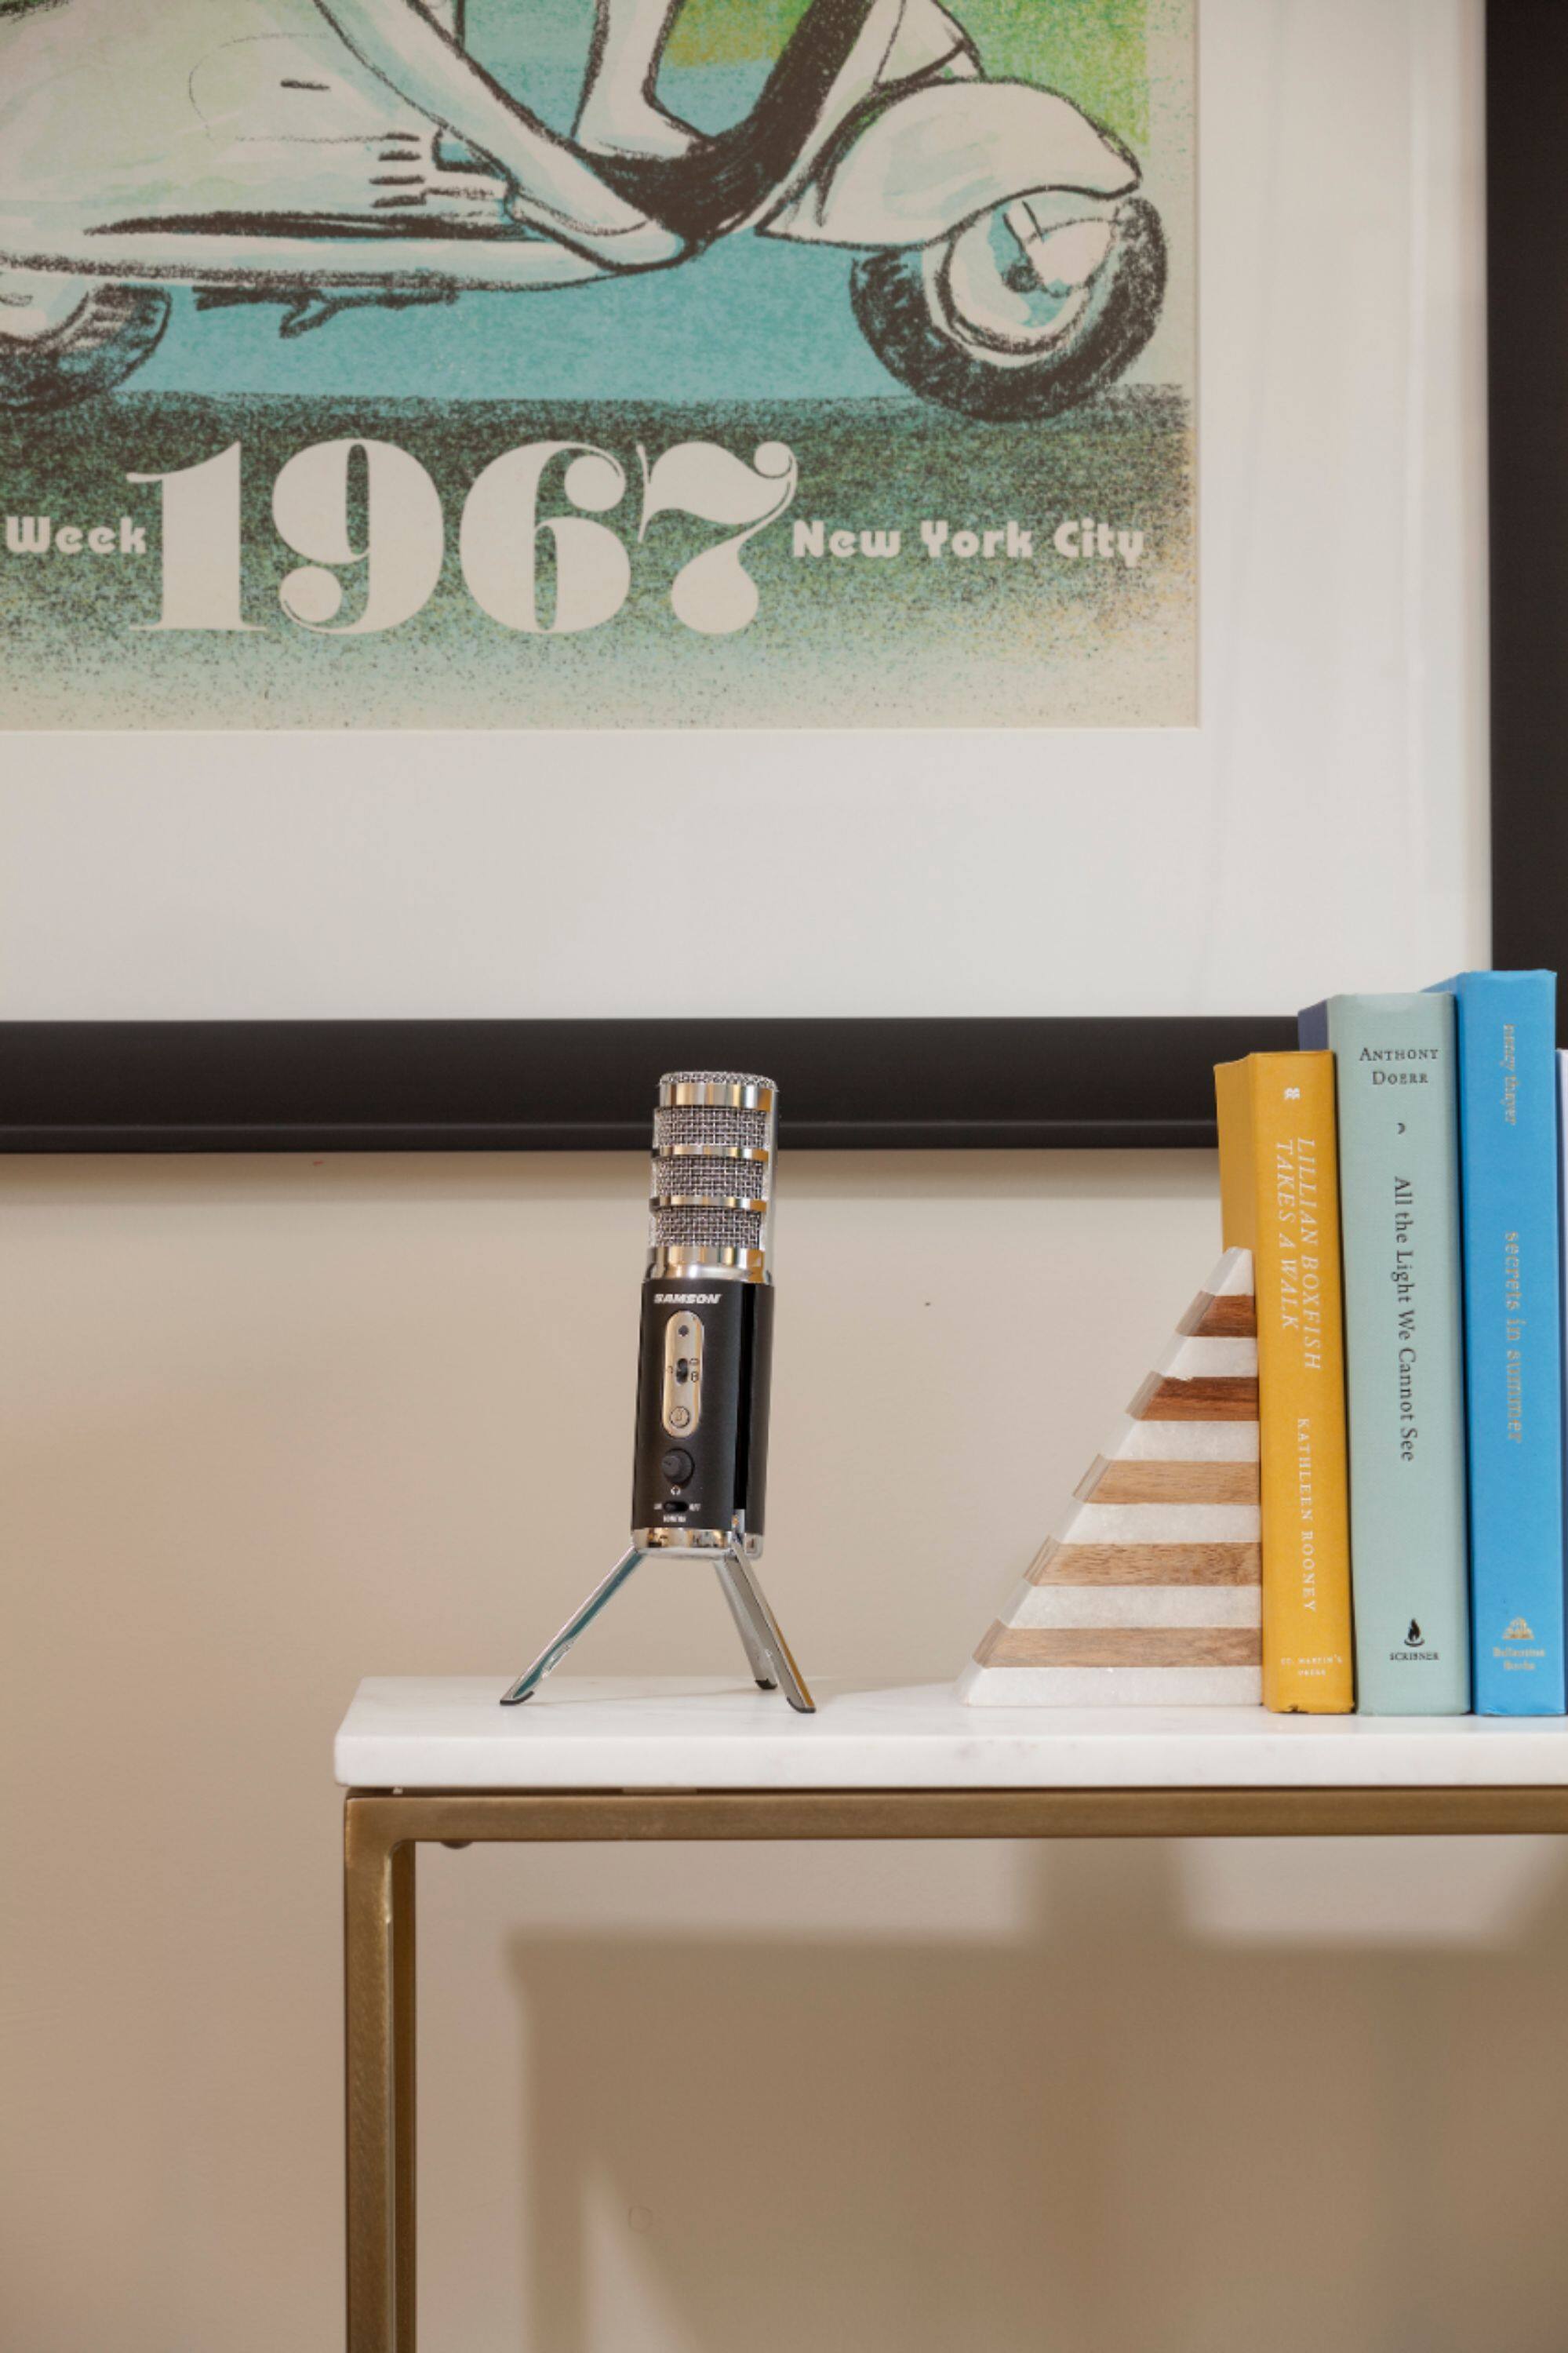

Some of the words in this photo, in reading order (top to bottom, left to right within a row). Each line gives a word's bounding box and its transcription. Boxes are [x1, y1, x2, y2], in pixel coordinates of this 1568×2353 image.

[5, 515, 147, 554] Week
[126, 438, 799, 635] 1967
[791, 519, 902, 558] New
[921, 521, 1035, 558] York
[1053, 518, 1145, 567] City
[1277, 1140, 1296, 1224] TAKES
[1298, 1137, 1319, 1246] LILLIAN
[1395, 1176, 1413, 1206] All
[1279, 1232, 1297, 1249] A
[1395, 1213, 1413, 1243] the
[654, 1293, 722, 1304] SAMSON
[1280, 1259, 1299, 1329] WALK
[1391, 1250, 1415, 1302] Light
[1505, 1231, 1522, 1311] secrets
[1301, 1255, 1322, 1369] BOXFISH
[1398, 1309, 1416, 1340] We
[1506, 1317, 1526, 1341] in
[1399, 1347, 1417, 1420] Cannot
[1506, 1350, 1523, 1443] summer
[1297, 1418, 1313, 1520] KATHLEEN
[1400, 1427, 1418, 1461] See
[1301, 1531, 1316, 1612] ROONEY
